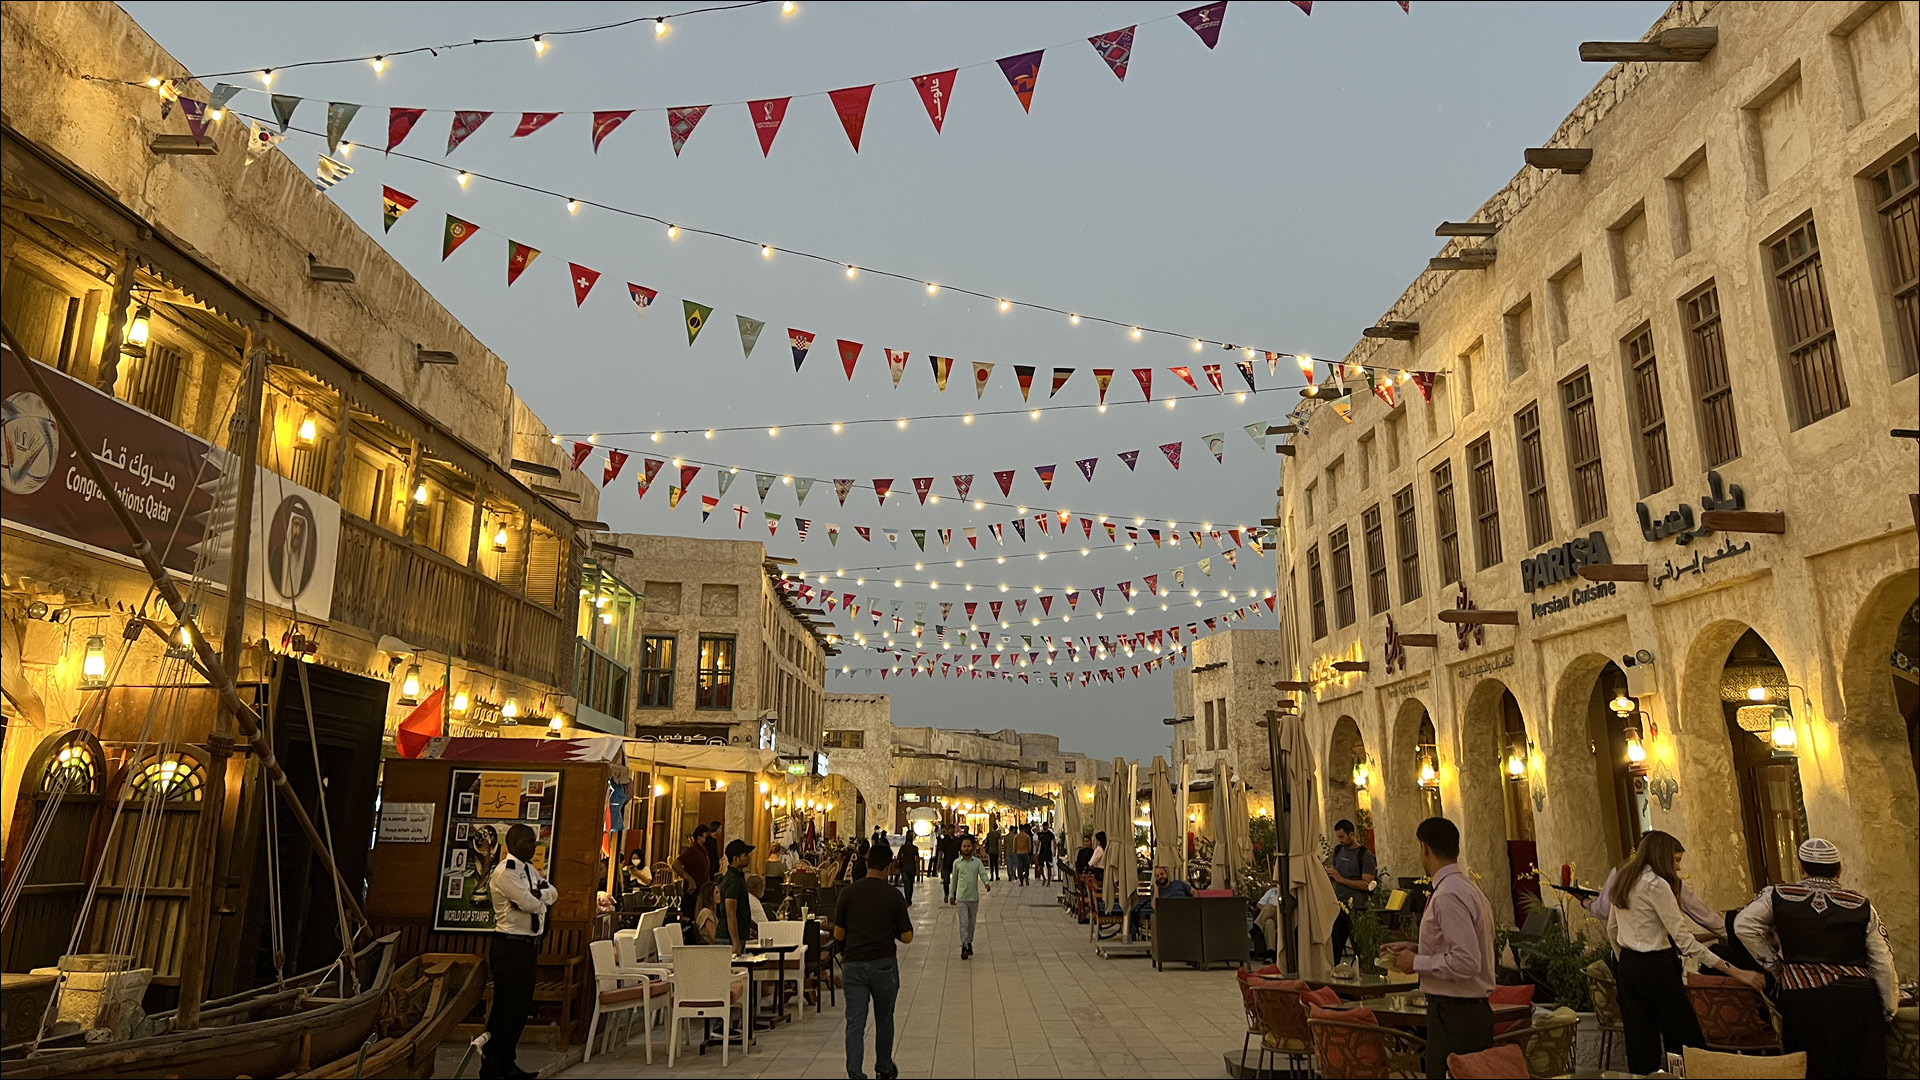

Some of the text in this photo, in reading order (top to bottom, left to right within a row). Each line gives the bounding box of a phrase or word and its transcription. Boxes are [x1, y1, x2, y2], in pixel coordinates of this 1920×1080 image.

[128, 453, 176, 494] مبروك
[66, 466, 172, 523] Congraations Qatar
[1520, 530, 1613, 594] PARISA
[1702, 538, 1751, 574] مطعم
[1531, 580, 1617, 621] Persian Cuisine
[472, 701, 500, 726] قهوة
[443, 909, 490, 923] WORLD CUP STAMPS
